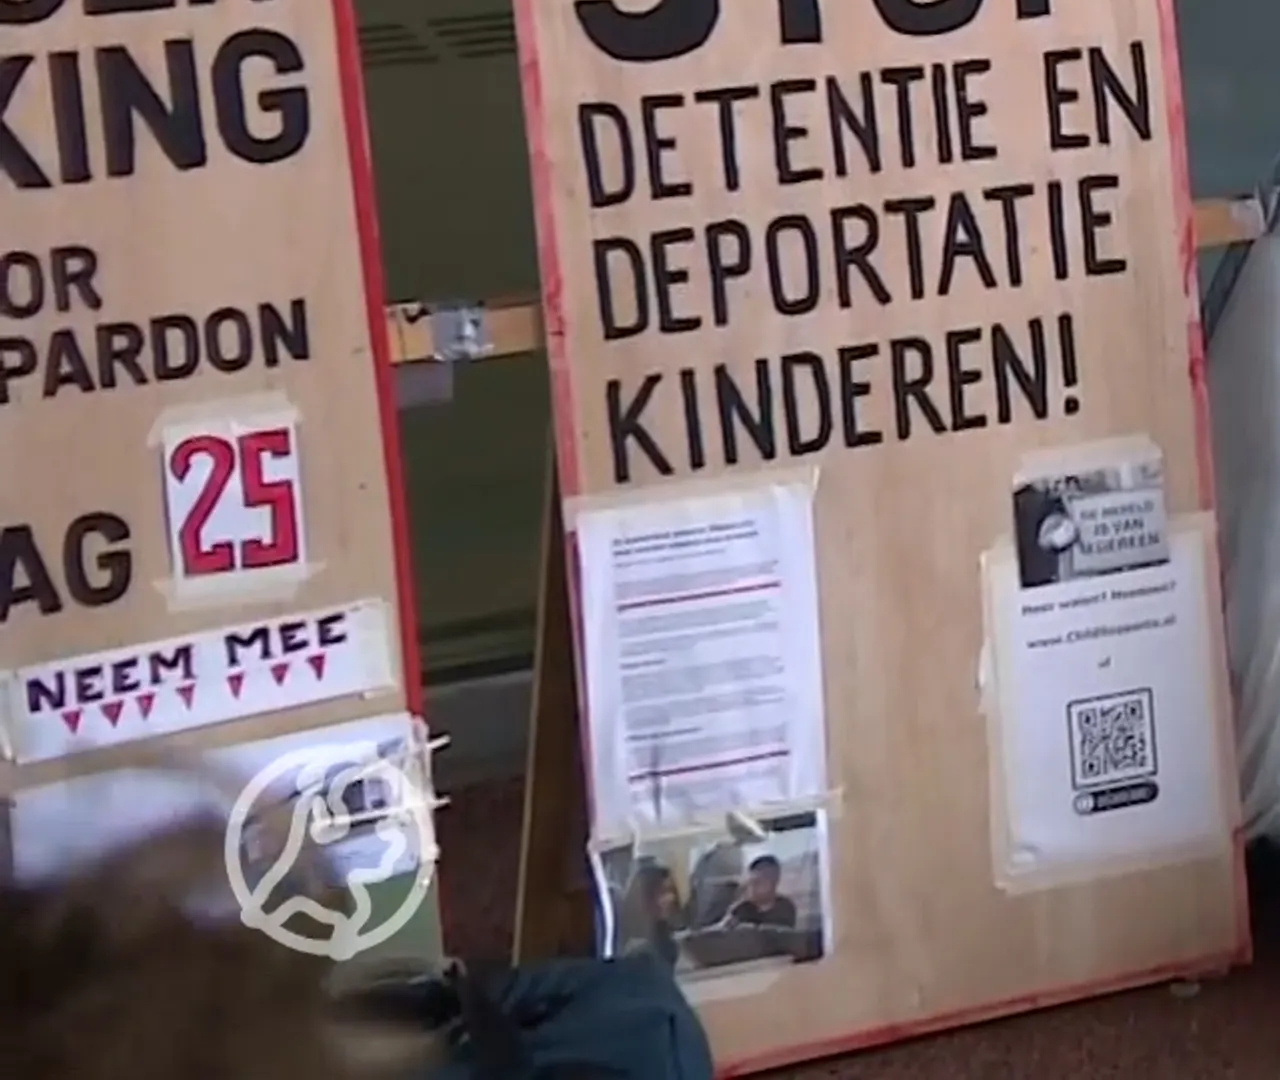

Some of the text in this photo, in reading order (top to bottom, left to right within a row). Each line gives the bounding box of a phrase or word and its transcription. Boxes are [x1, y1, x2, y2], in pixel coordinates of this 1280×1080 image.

[578, 40, 1152, 208] DETENTIE EN
[0, 245, 103, 318] OR
[592, 175, 1127, 341] DEPORTATIE
[605, 314, 1080, 483] KINDEREN!
[170, 426, 300, 578] 25
[26, 612, 348, 714] NEEM MEE
